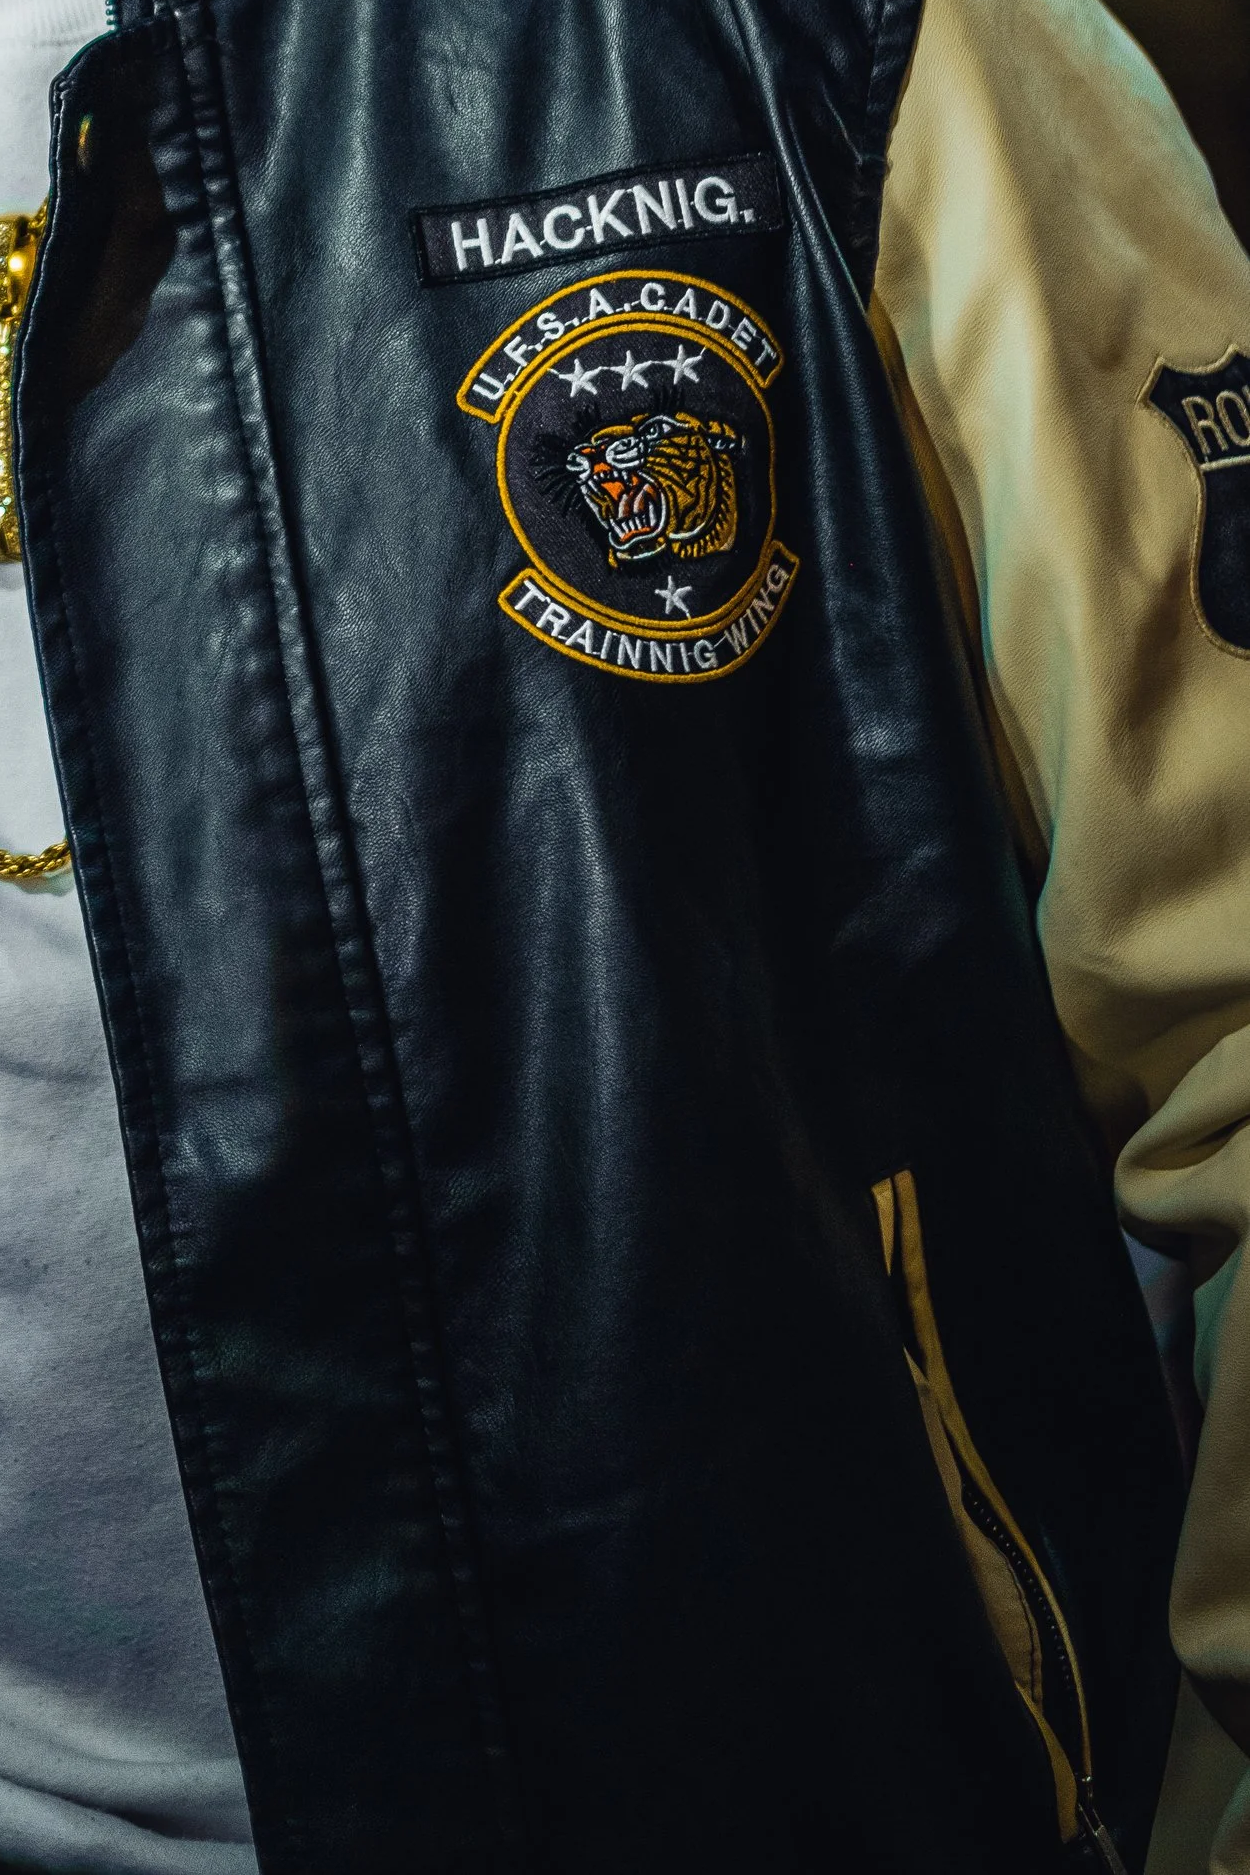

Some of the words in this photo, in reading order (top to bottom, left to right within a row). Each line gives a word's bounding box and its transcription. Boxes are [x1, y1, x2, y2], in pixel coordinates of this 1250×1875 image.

[451, 176, 757, 271] HACKNIG.
[1181, 385, 1250, 454] RO
[514, 578, 719, 673] TRAINNIG
[724, 563, 789, 656] WING
